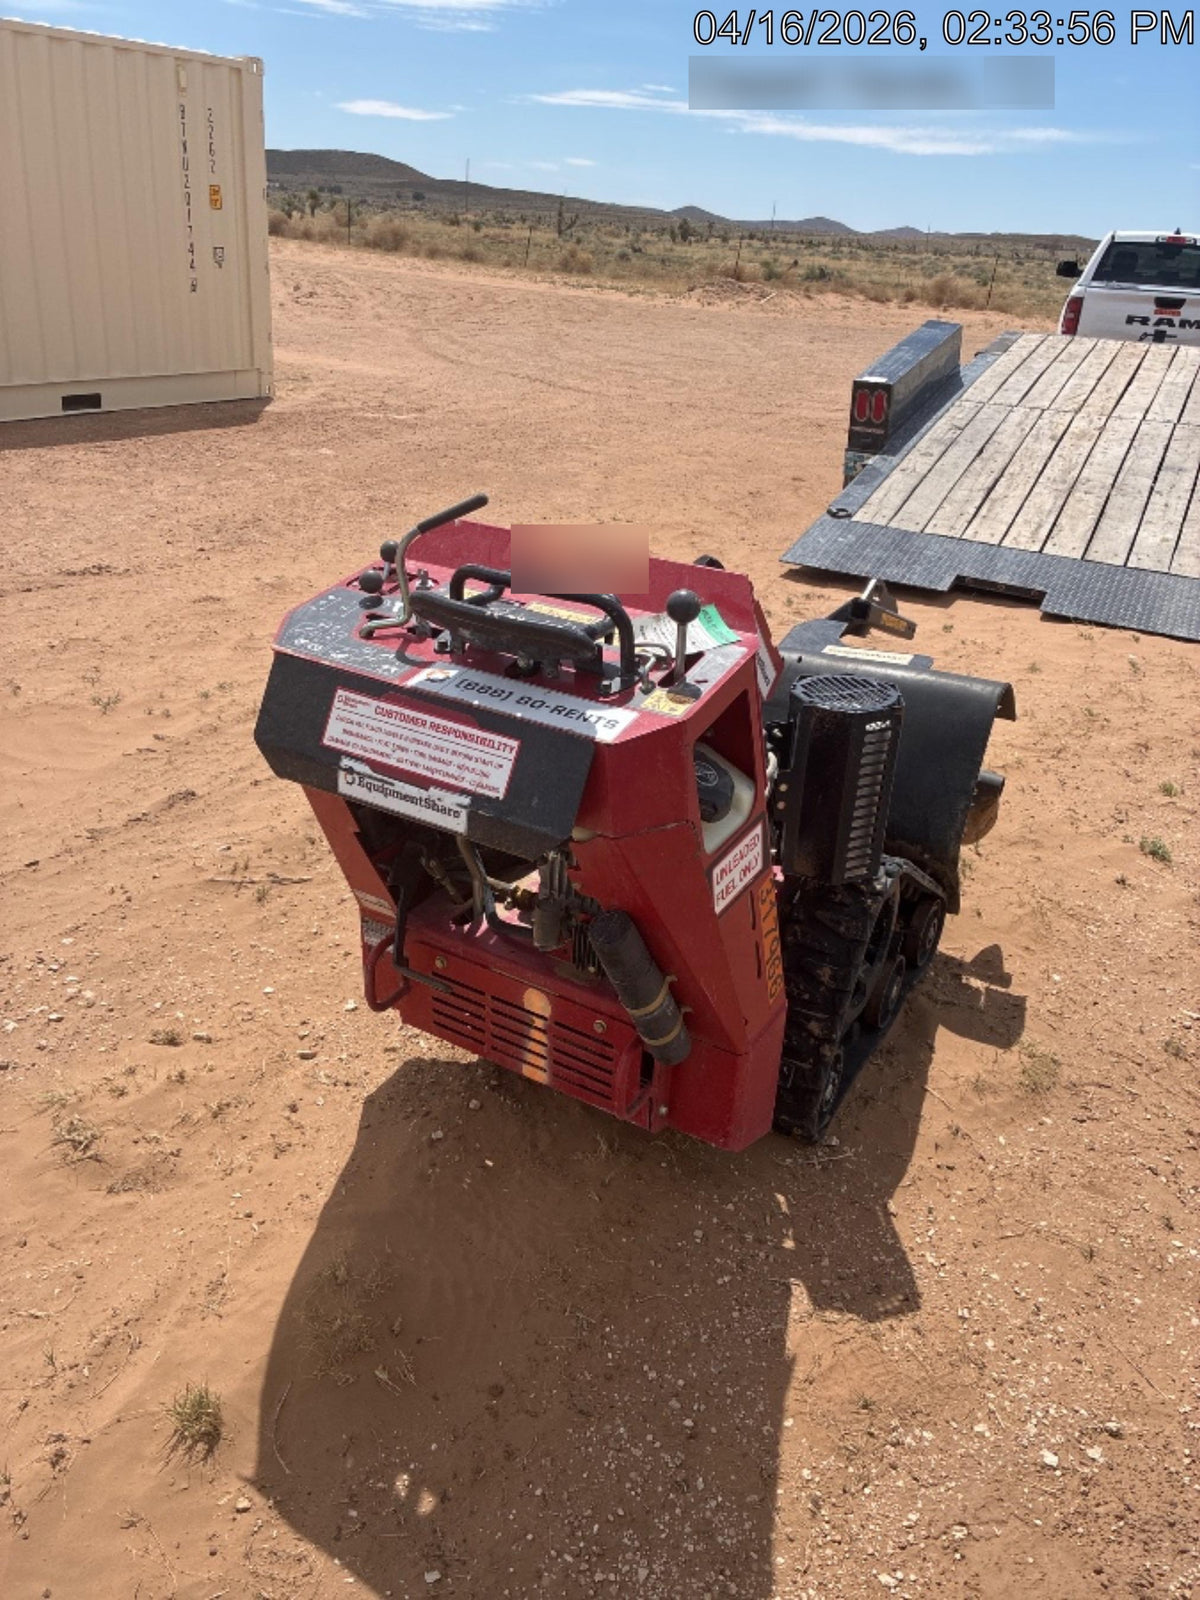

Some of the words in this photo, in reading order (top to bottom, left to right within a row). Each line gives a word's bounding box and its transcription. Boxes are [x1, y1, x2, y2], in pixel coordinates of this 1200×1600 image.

[1125, 314, 1200, 330] RAM
[454, 678, 512, 703] (888)
[374, 704, 428, 729] CUSTOMER
[428, 720, 516, 754] RESPONSIBILITY
[356, 775, 462, 819] EquipmentShare
[715, 832, 760, 886] UNLEADED
[715, 878, 738, 907] FUEL
[738, 852, 761, 883] ONLY
